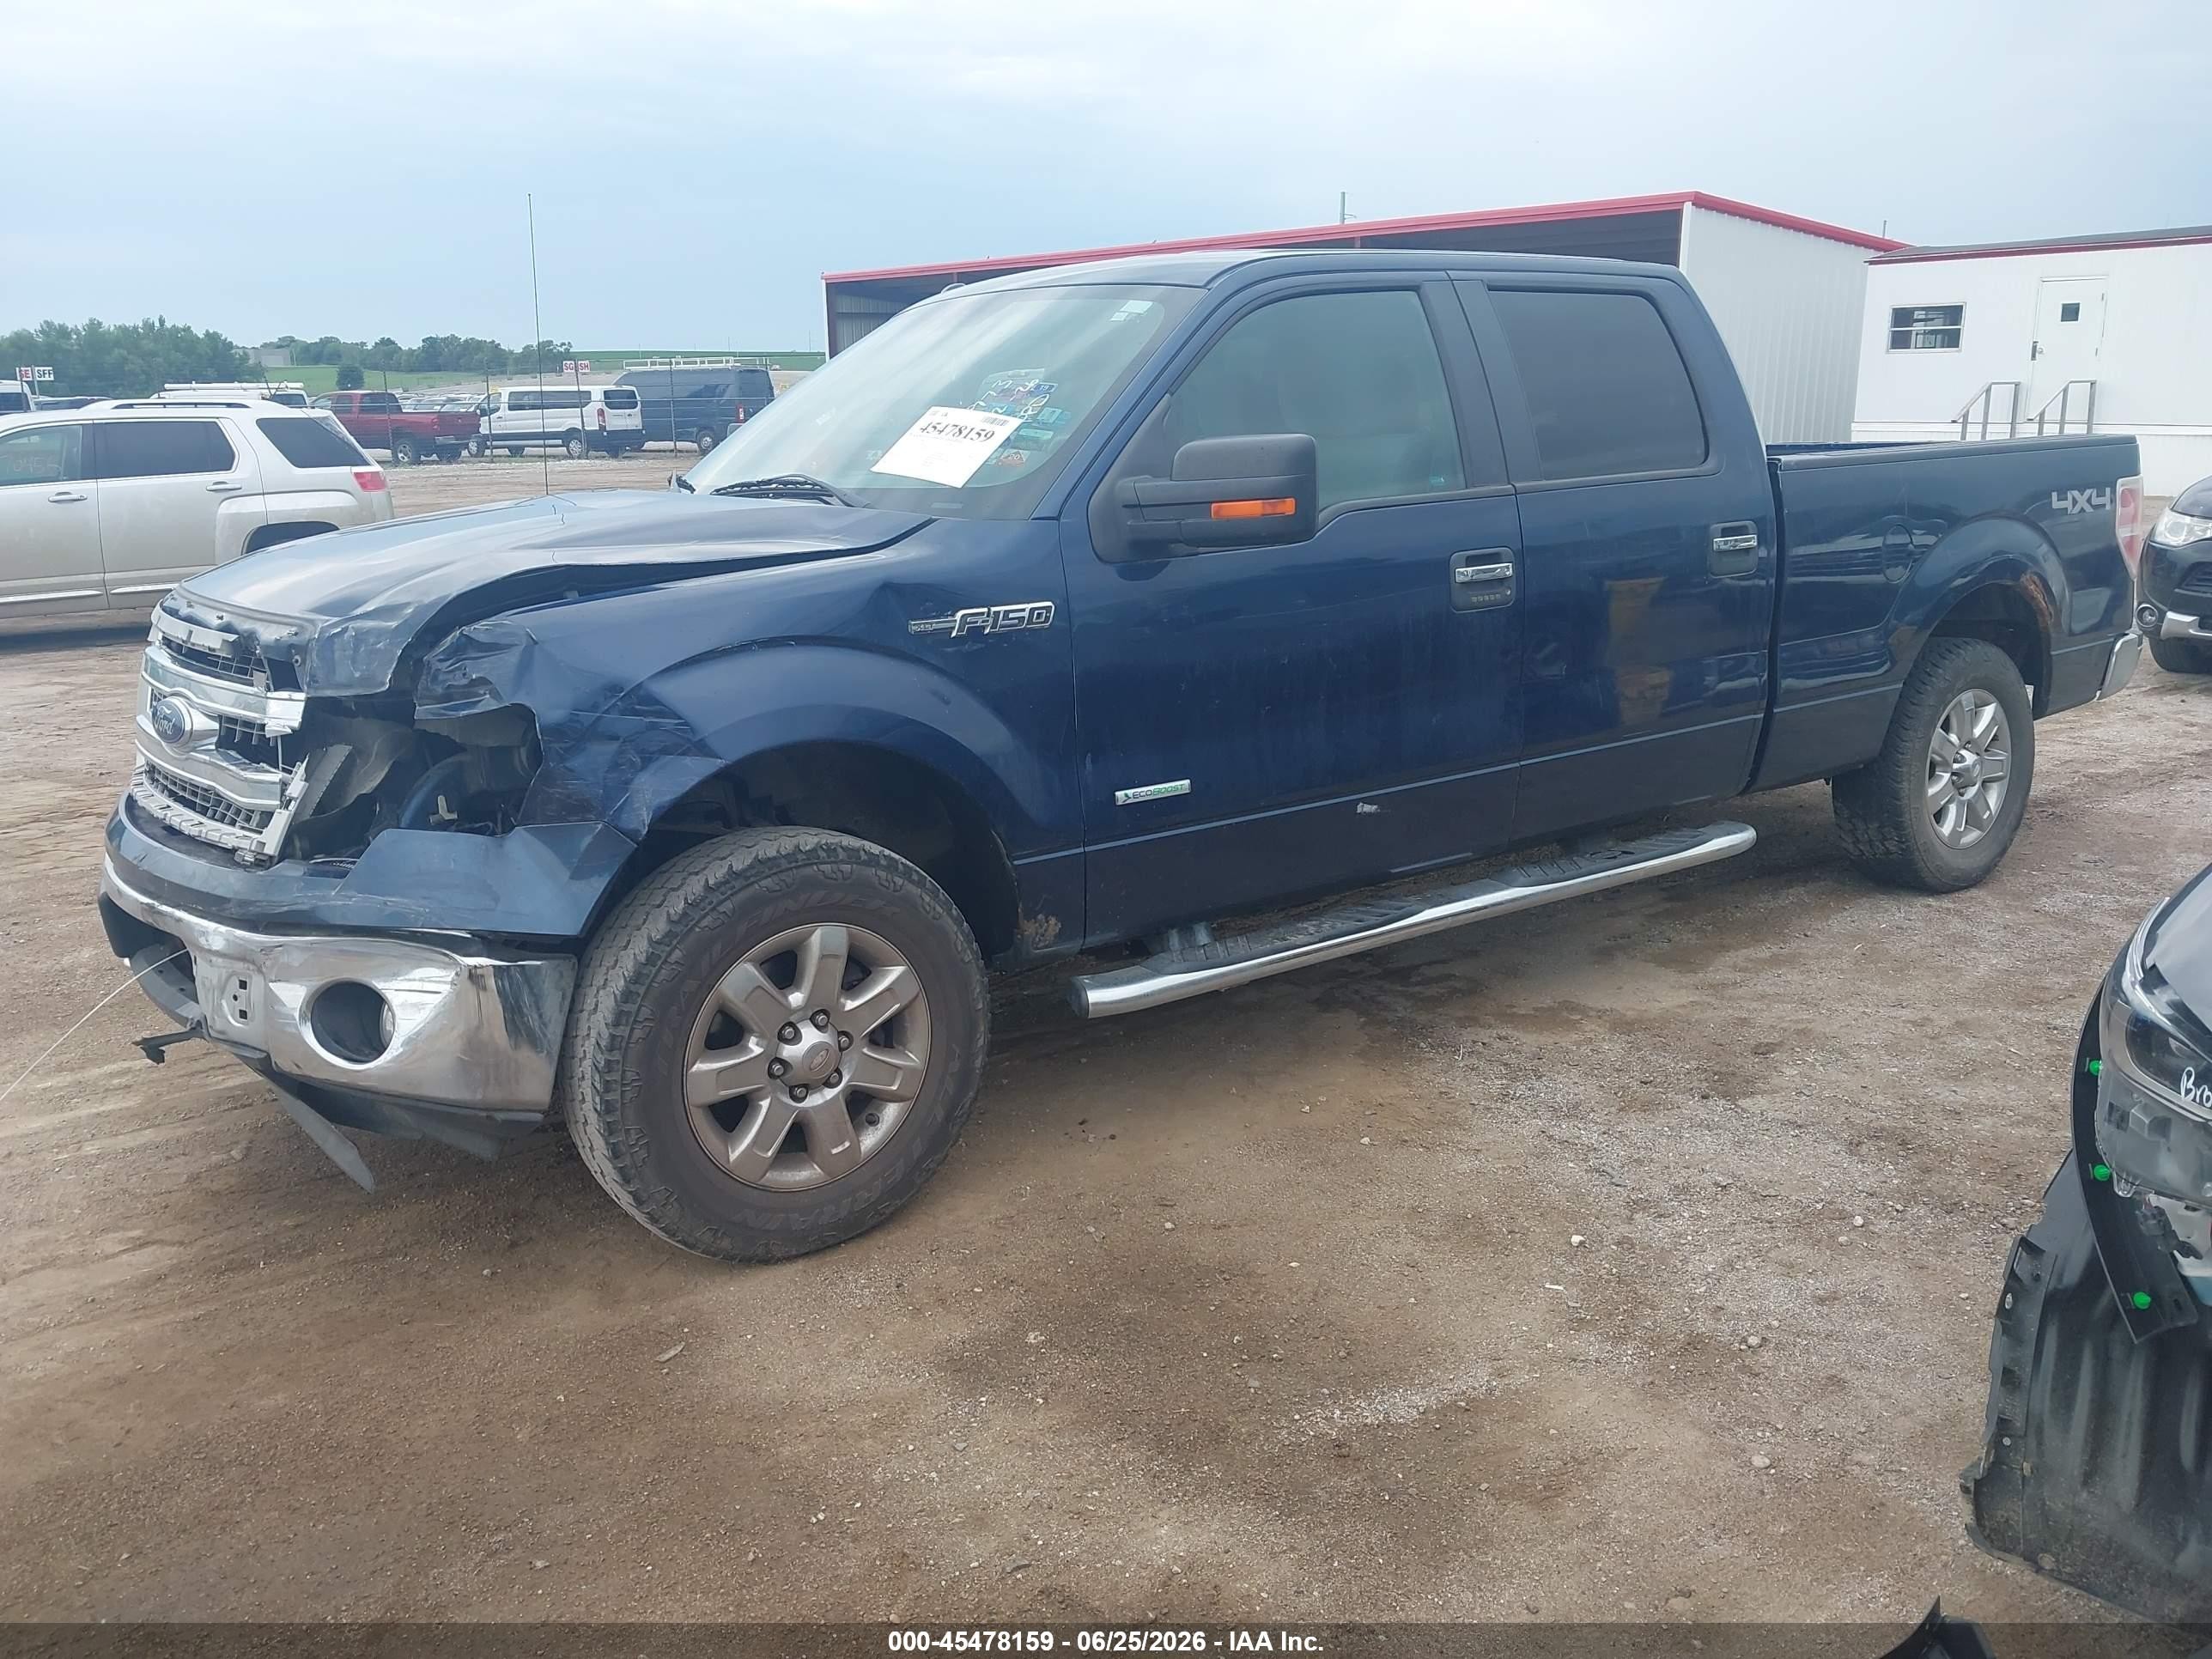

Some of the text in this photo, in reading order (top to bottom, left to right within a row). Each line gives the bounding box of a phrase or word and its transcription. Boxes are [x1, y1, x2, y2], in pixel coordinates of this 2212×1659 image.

[563, 362, 574, 371] SG
[579, 362, 589, 371] SH
[20, 369, 31, 379] SE
[36, 369, 53, 379] SFF
[920, 421, 995, 443] 45478159
[950, 600, 1056, 639] F-150
[153, 704, 176, 735] Ford
[1132, 783, 1186, 799] ECOBOOST
